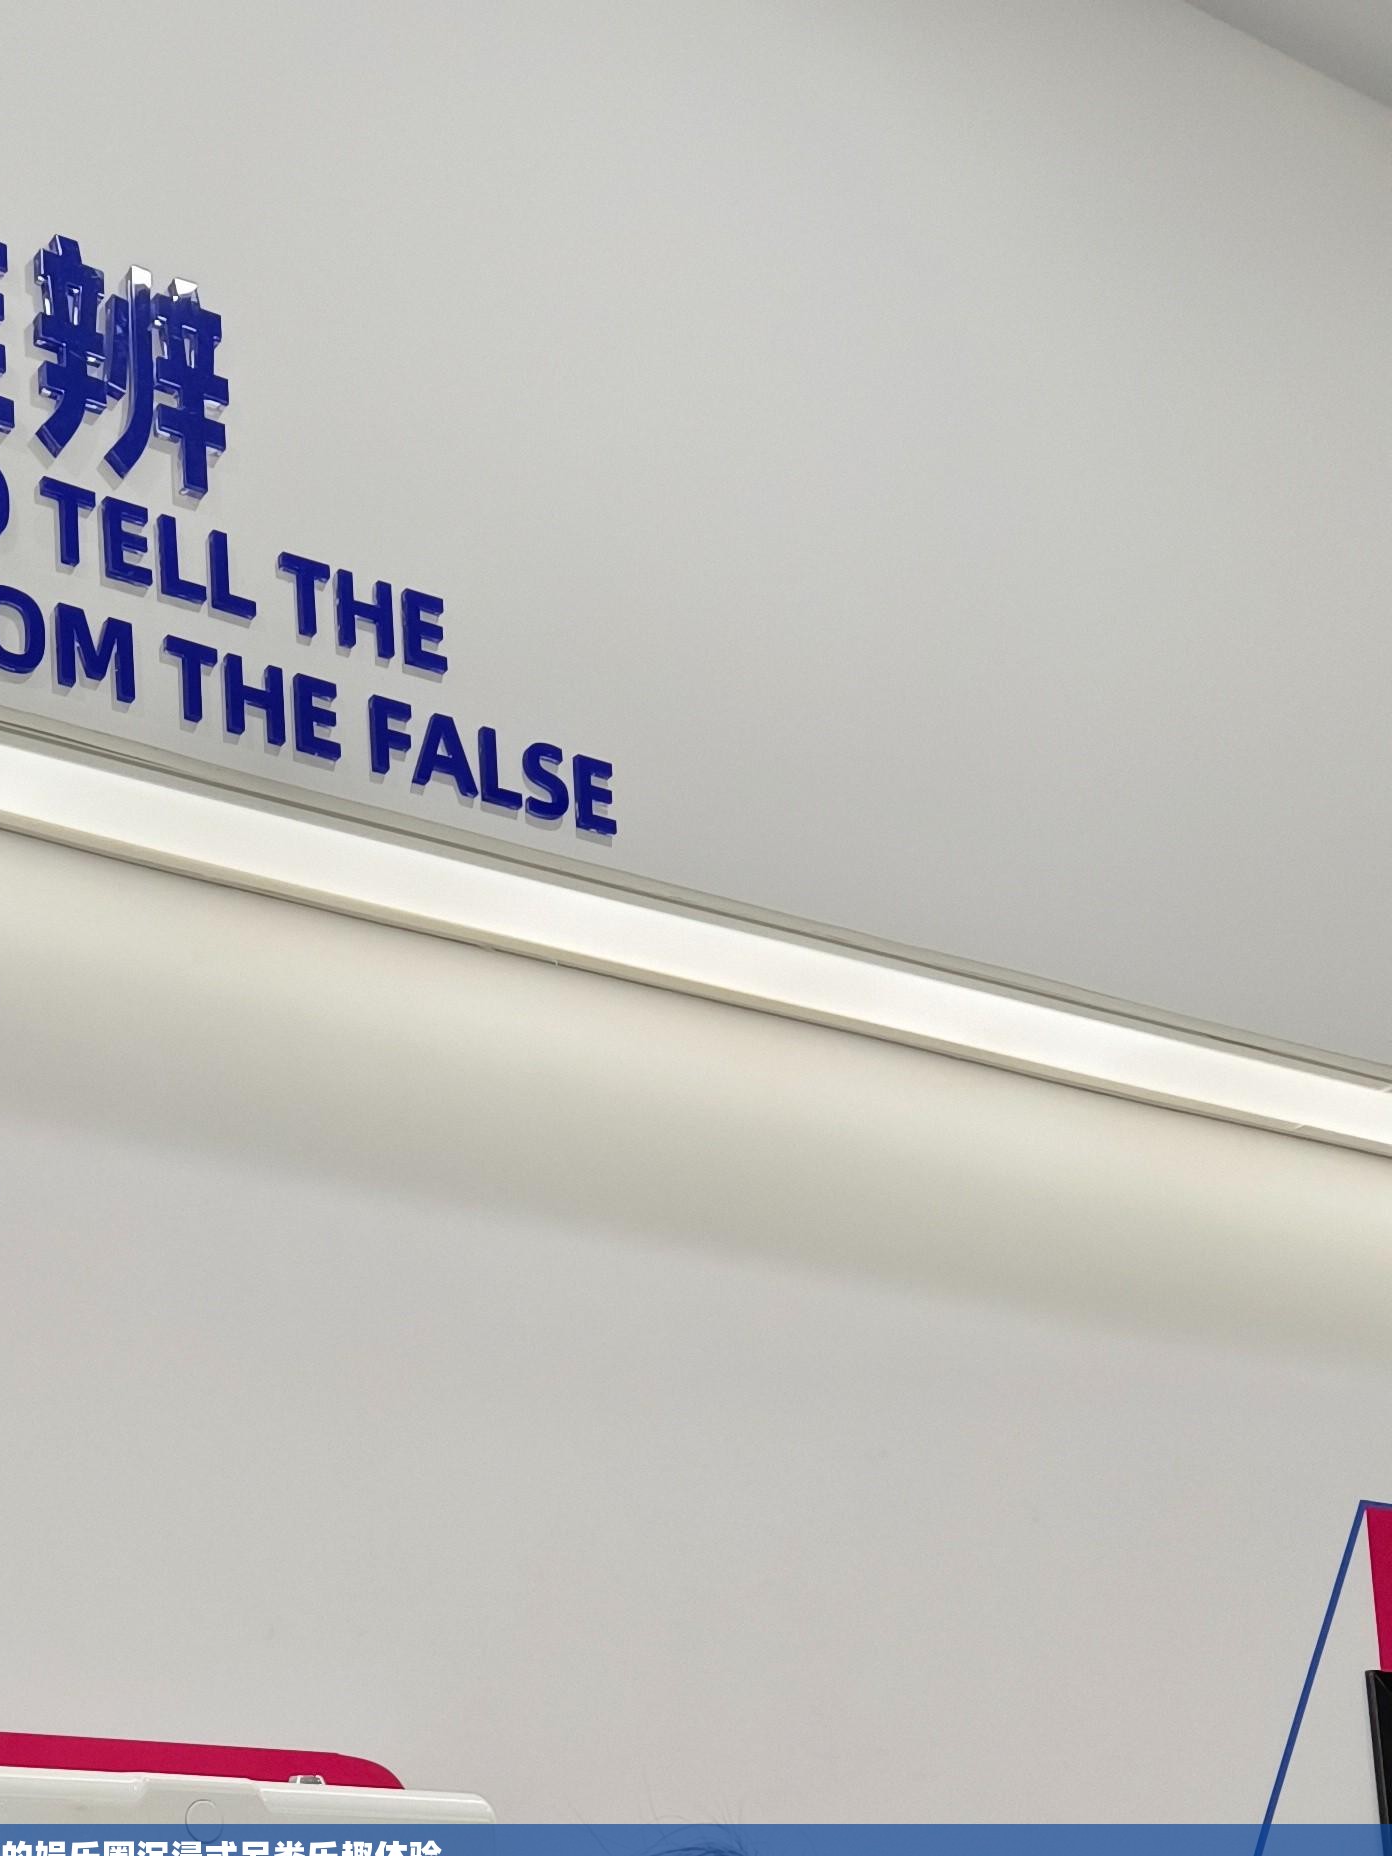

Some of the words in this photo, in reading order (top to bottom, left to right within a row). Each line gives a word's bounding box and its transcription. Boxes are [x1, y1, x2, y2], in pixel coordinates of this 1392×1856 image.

[41, 478, 258, 620] TELL
[279, 552, 448, 675] THE
[164, 636, 341, 761] THE
[370, 695, 617, 837] FALSE
